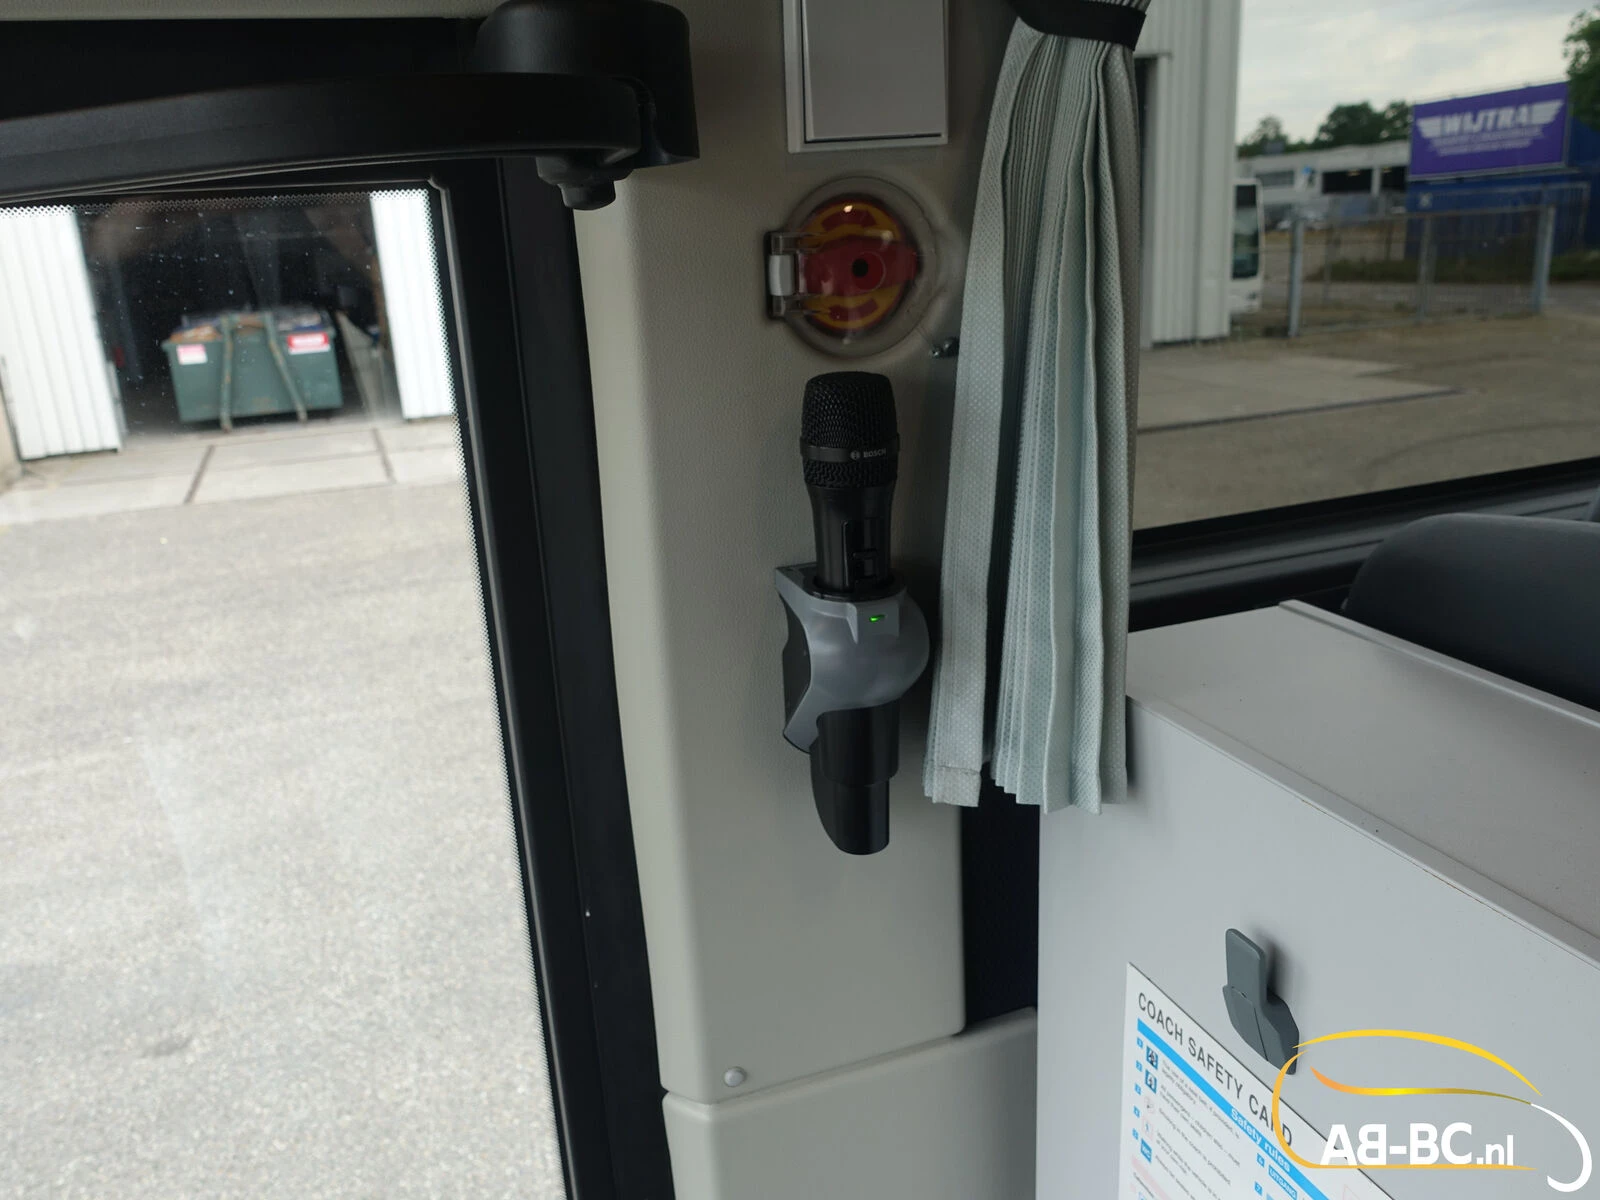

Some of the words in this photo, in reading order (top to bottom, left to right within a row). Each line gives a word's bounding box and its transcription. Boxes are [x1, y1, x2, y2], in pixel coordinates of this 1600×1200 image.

[863, 448, 887, 457] BOSCH
[1138, 992, 1184, 1046] COACH
[1188, 1037, 1243, 1099] SAFETY
[1230, 1107, 1263, 1148] Safety
[1263, 1140, 1291, 1173] rules
